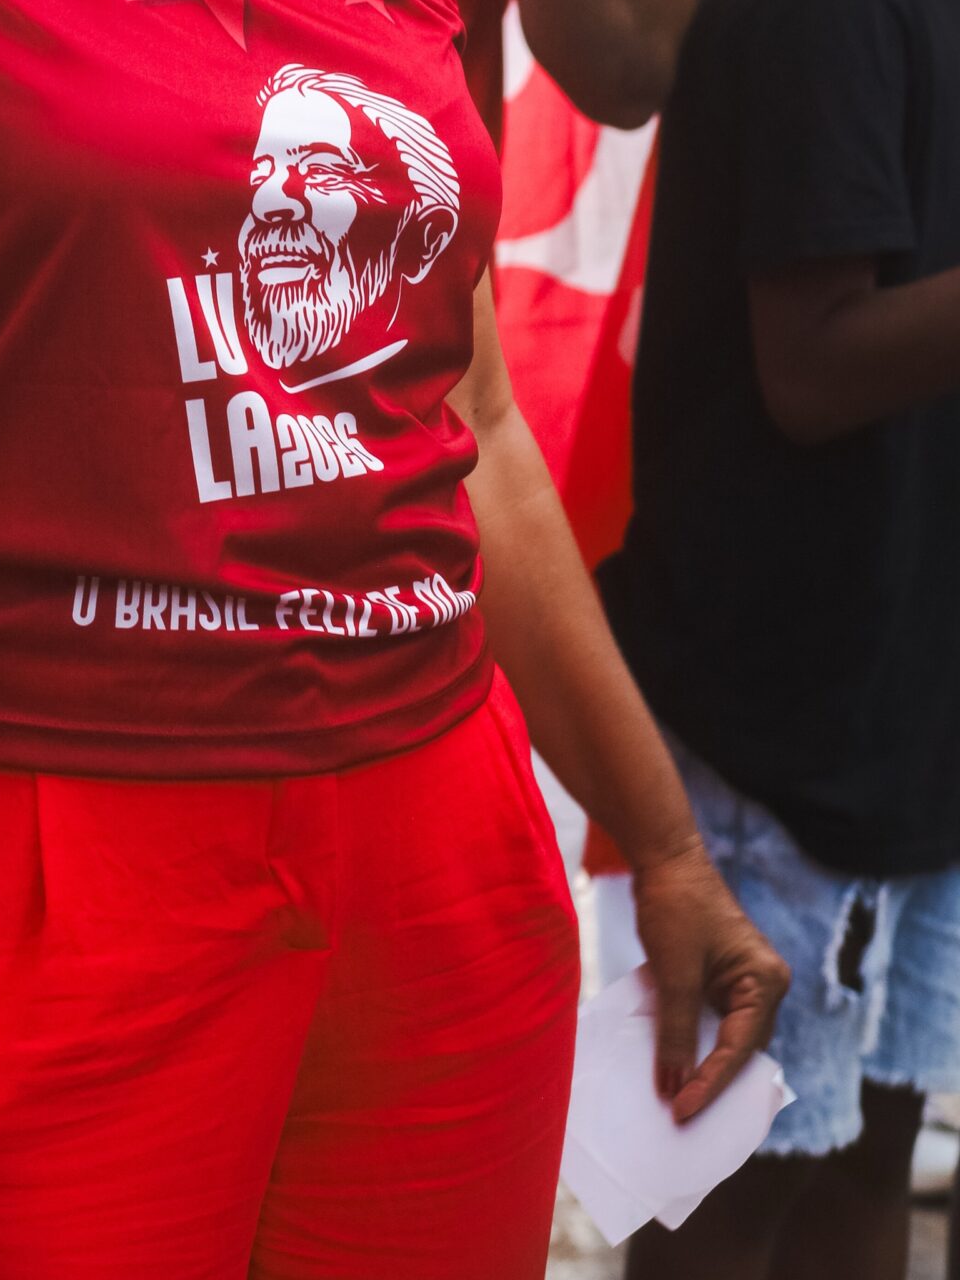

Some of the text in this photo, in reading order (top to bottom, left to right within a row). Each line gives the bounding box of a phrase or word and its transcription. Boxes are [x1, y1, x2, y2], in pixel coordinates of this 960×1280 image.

[114, 580, 259, 631] BRASIL
[275, 588, 378, 638] FELIZ
[364, 585, 423, 636] DE
